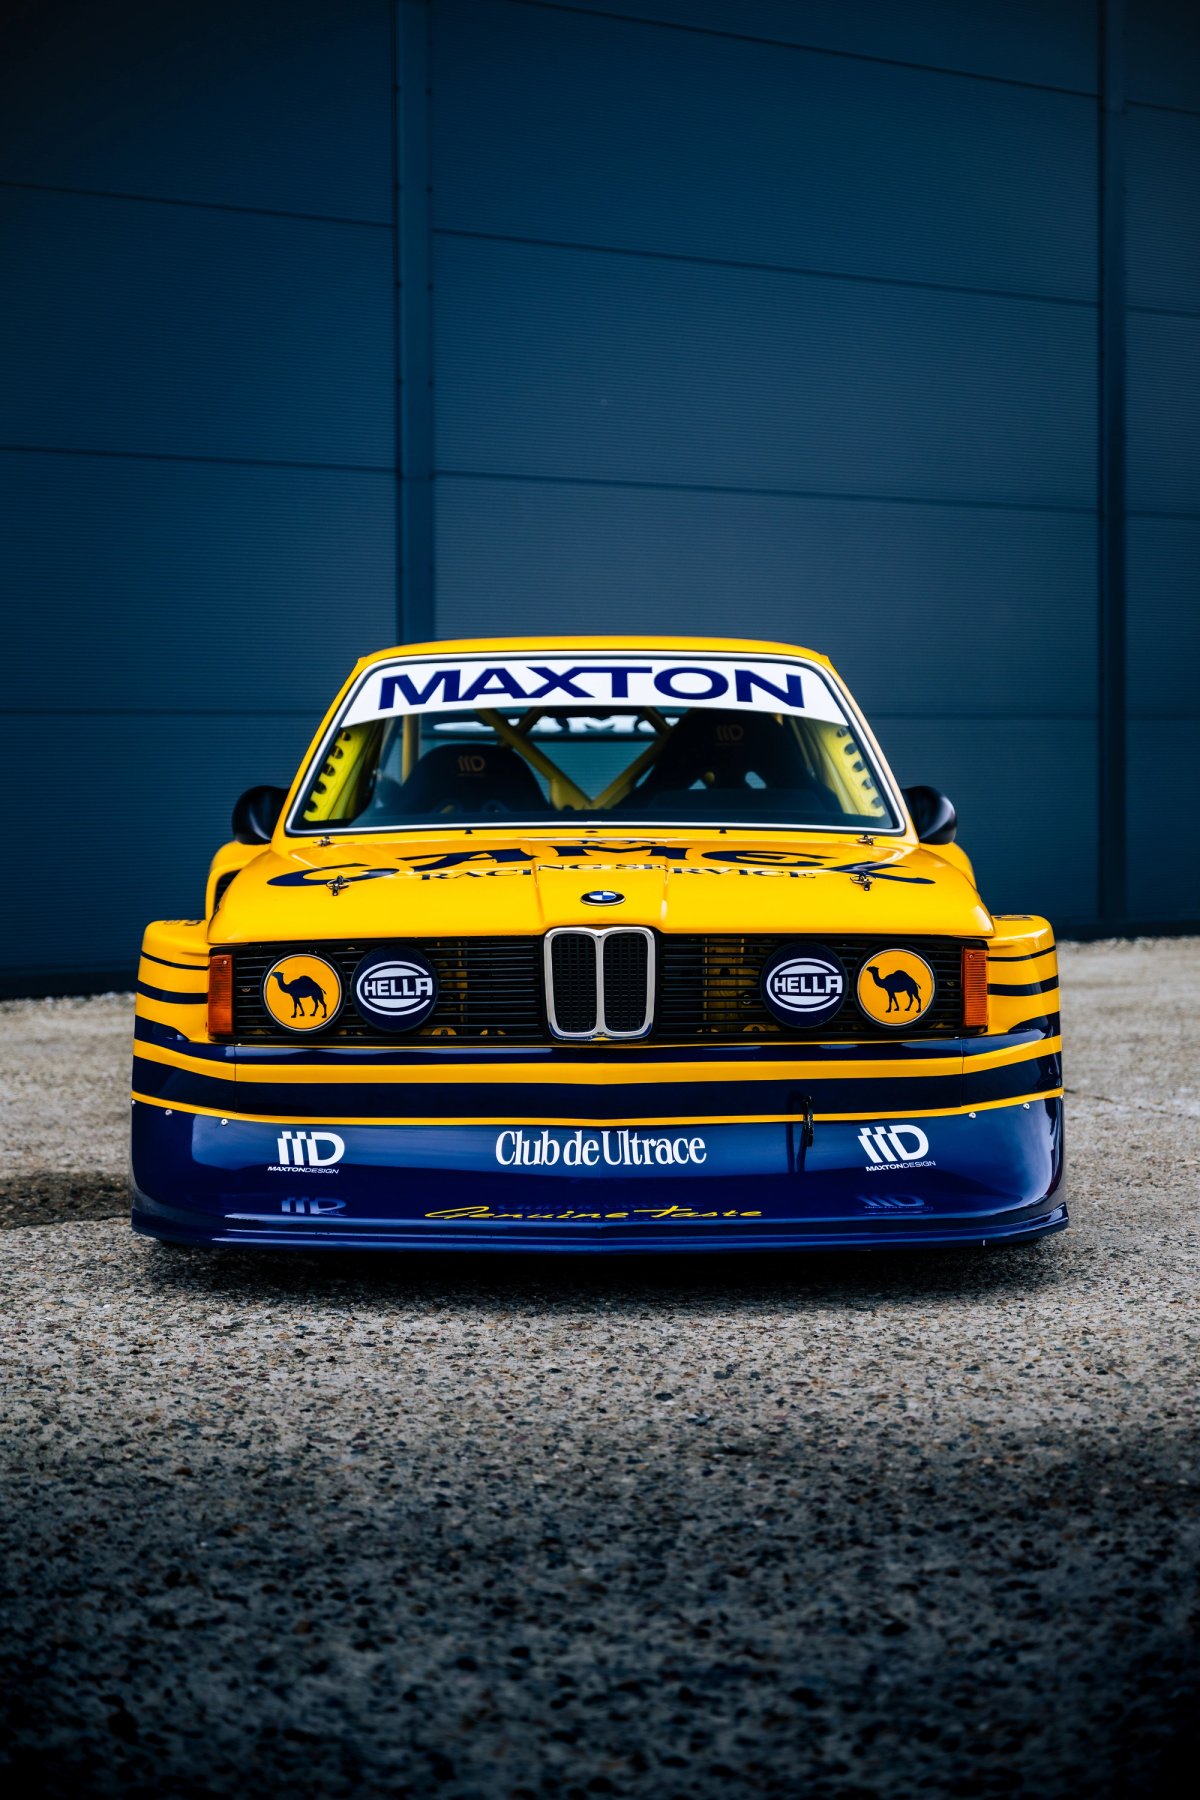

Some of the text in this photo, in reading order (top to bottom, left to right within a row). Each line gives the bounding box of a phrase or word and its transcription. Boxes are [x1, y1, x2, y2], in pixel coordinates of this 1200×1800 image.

[378, 666, 806, 710] MAXTON
[266, 845, 935, 886] CAMEL
[364, 977, 433, 996] HELLA
[774, 975, 843, 994] HELLA
[495, 1129, 707, 1166] Club de Ultrace
[425, 1206, 629, 1219] Genuine
[633, 1205, 762, 1218] Taste
